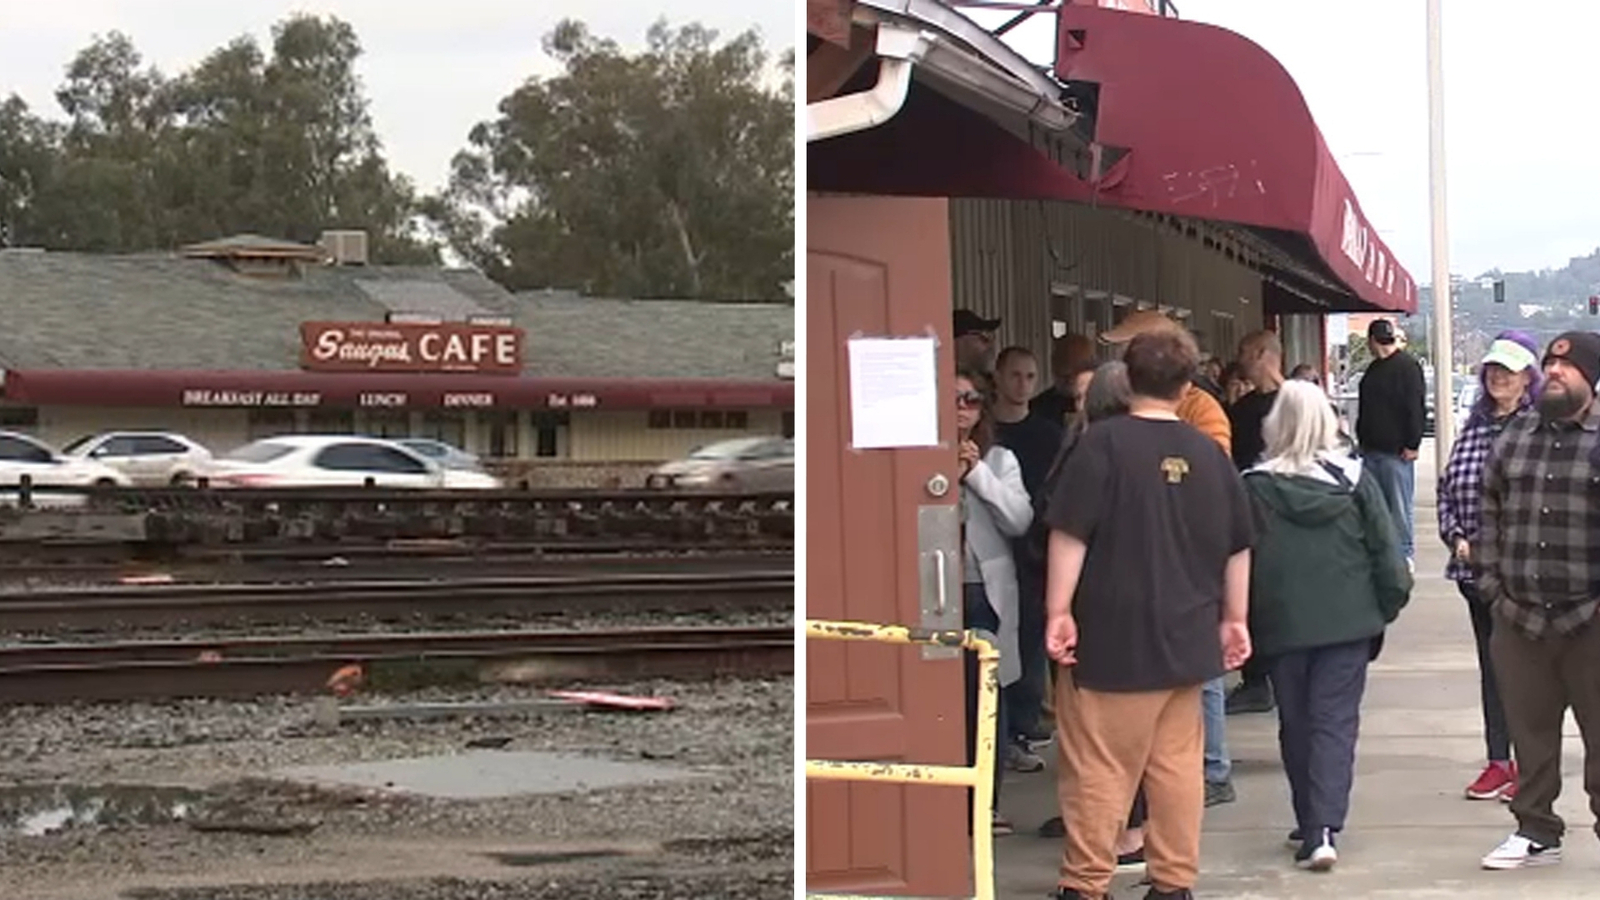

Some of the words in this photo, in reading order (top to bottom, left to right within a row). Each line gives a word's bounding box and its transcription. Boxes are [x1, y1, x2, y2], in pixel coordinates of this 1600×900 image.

[419, 333, 516, 364] CAFE
[360, 393, 408, 407] LUNCH
[443, 393, 493, 407] DINNER
